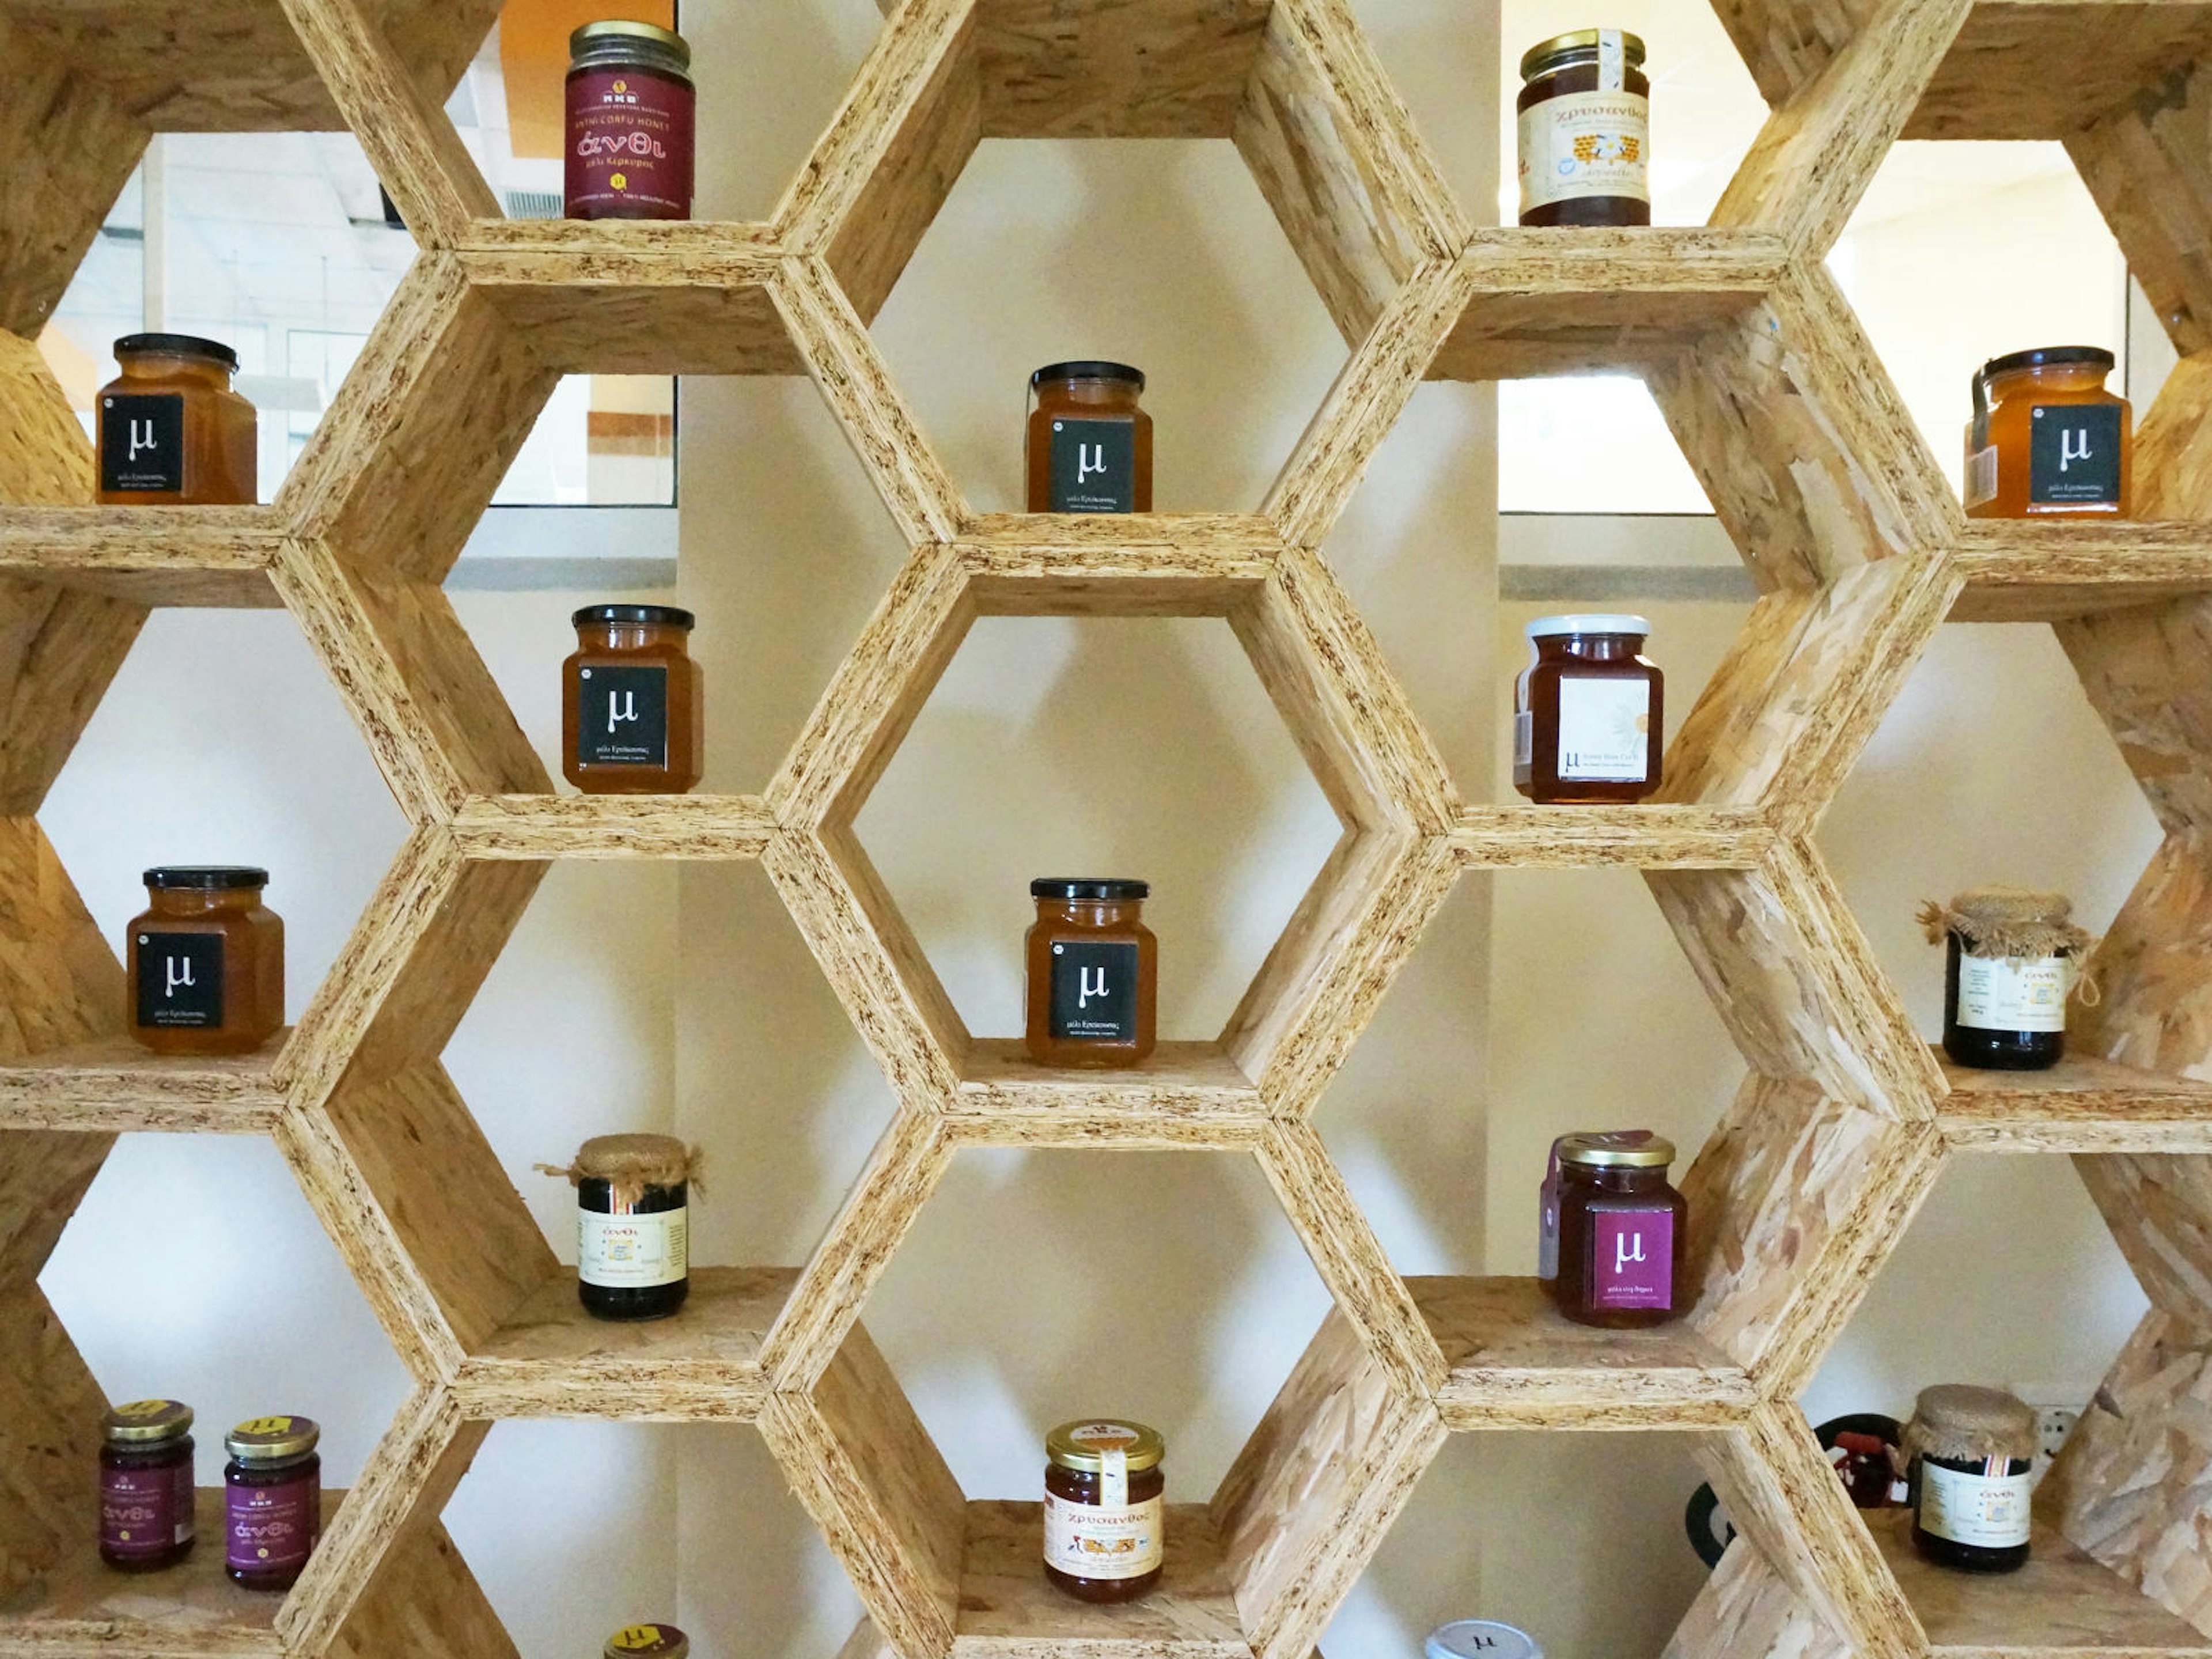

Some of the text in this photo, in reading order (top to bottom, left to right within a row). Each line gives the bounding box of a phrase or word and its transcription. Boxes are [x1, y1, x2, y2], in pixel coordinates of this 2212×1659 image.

[128, 419, 158, 461] μ
[2059, 429, 2093, 472] μ
[1077, 443, 1107, 484] μ
[607, 691, 639, 734] μ
[165, 956, 196, 998] μ
[1078, 966, 1110, 1009] μ
[1615, 1232, 1646, 1274] μ
